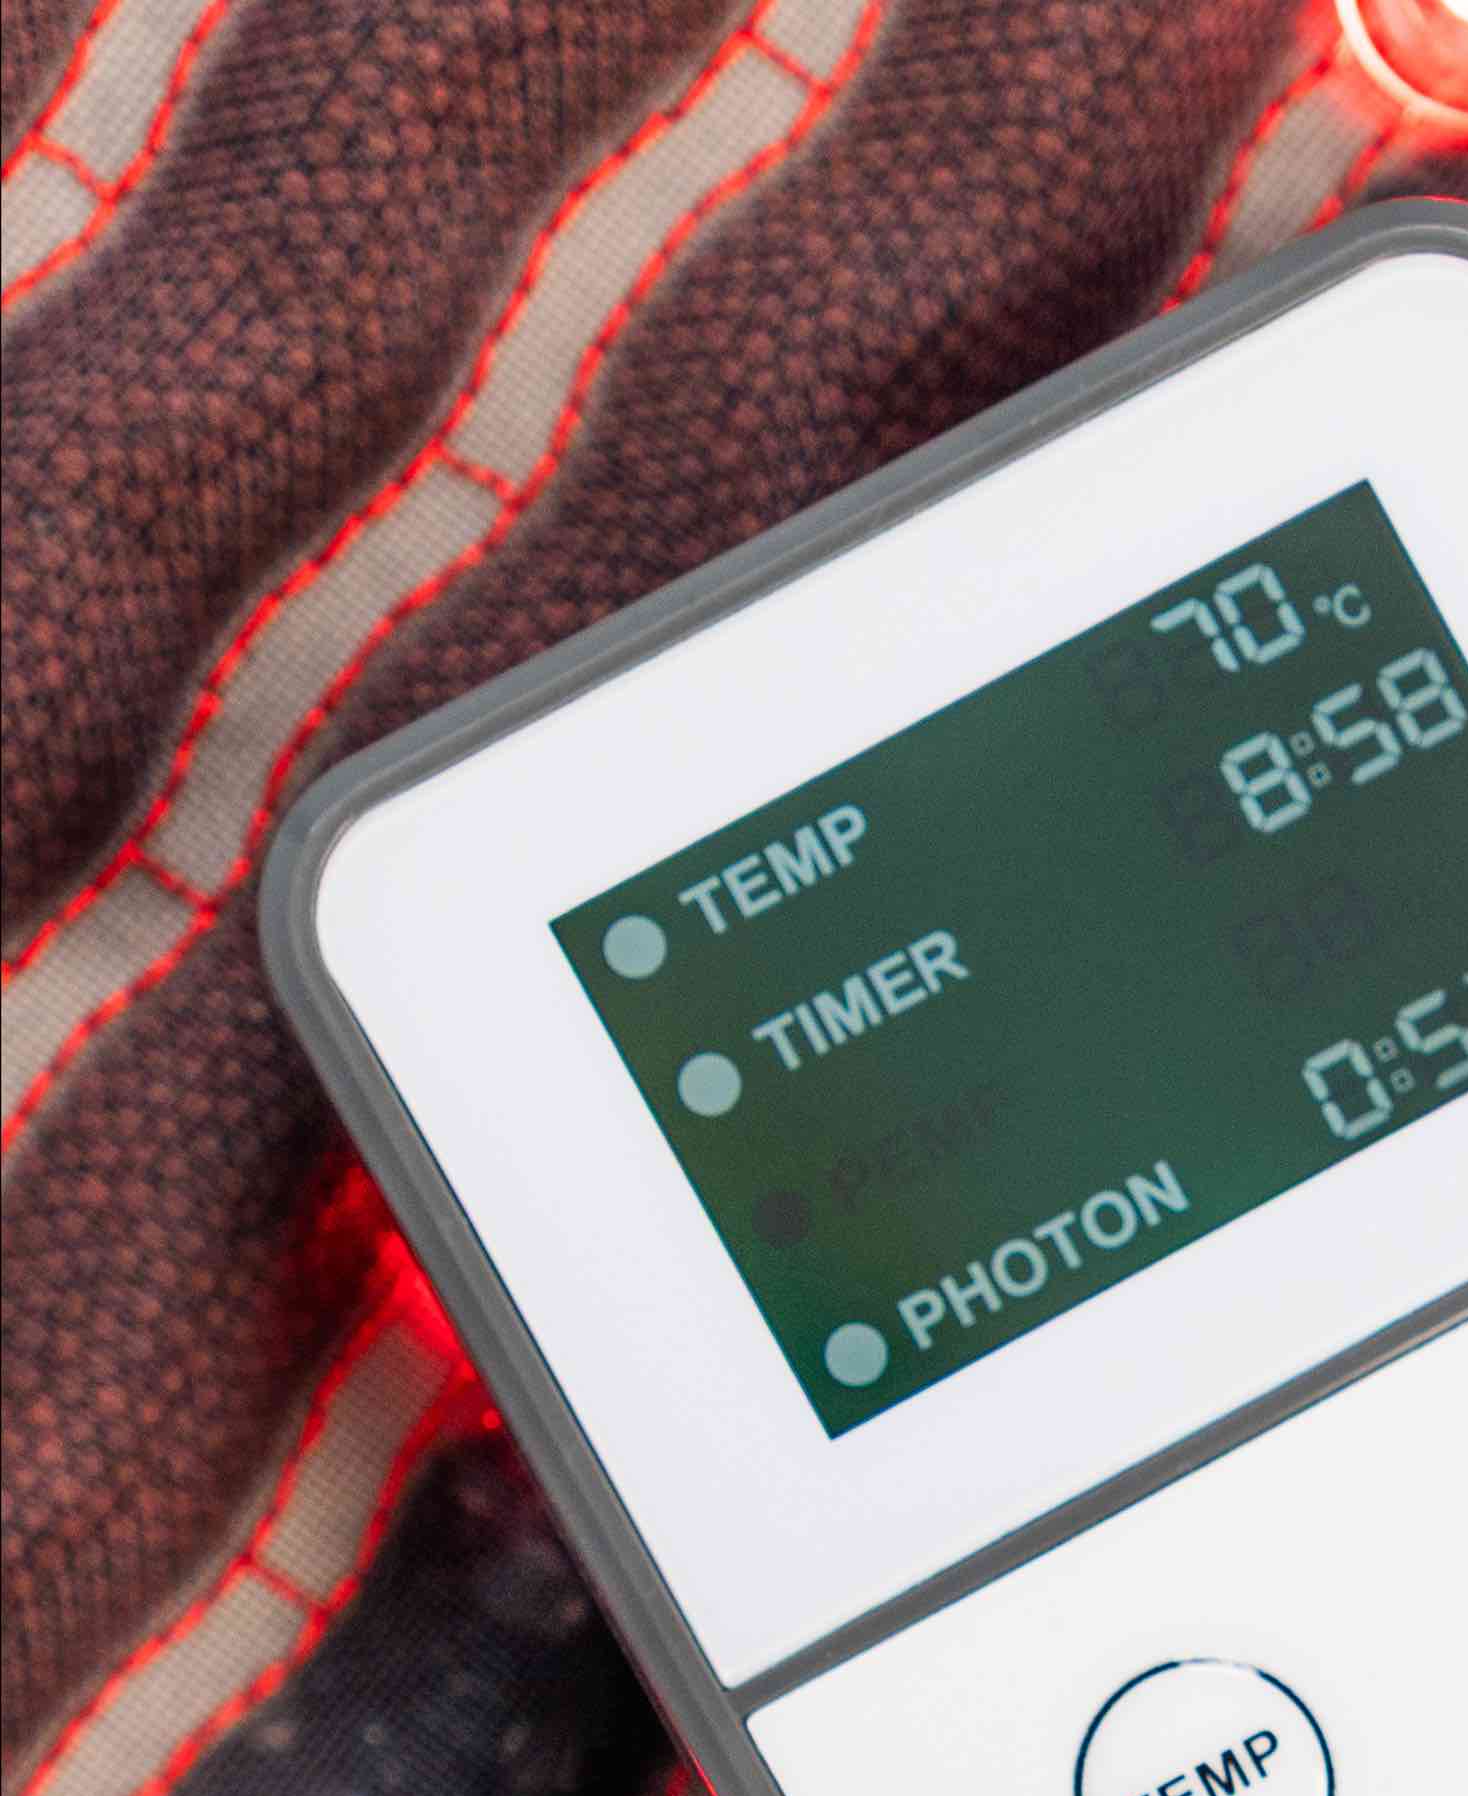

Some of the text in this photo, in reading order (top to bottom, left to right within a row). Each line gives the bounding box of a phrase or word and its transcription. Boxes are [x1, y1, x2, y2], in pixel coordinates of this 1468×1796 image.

[677, 803, 868, 935] TEMP
[1150, 562, 1306, 673] 70
[752, 929, 971, 1071] TIMER
[1219, 647, 1468, 834] 8:58
[896, 1158, 1190, 1350] PHOTON
